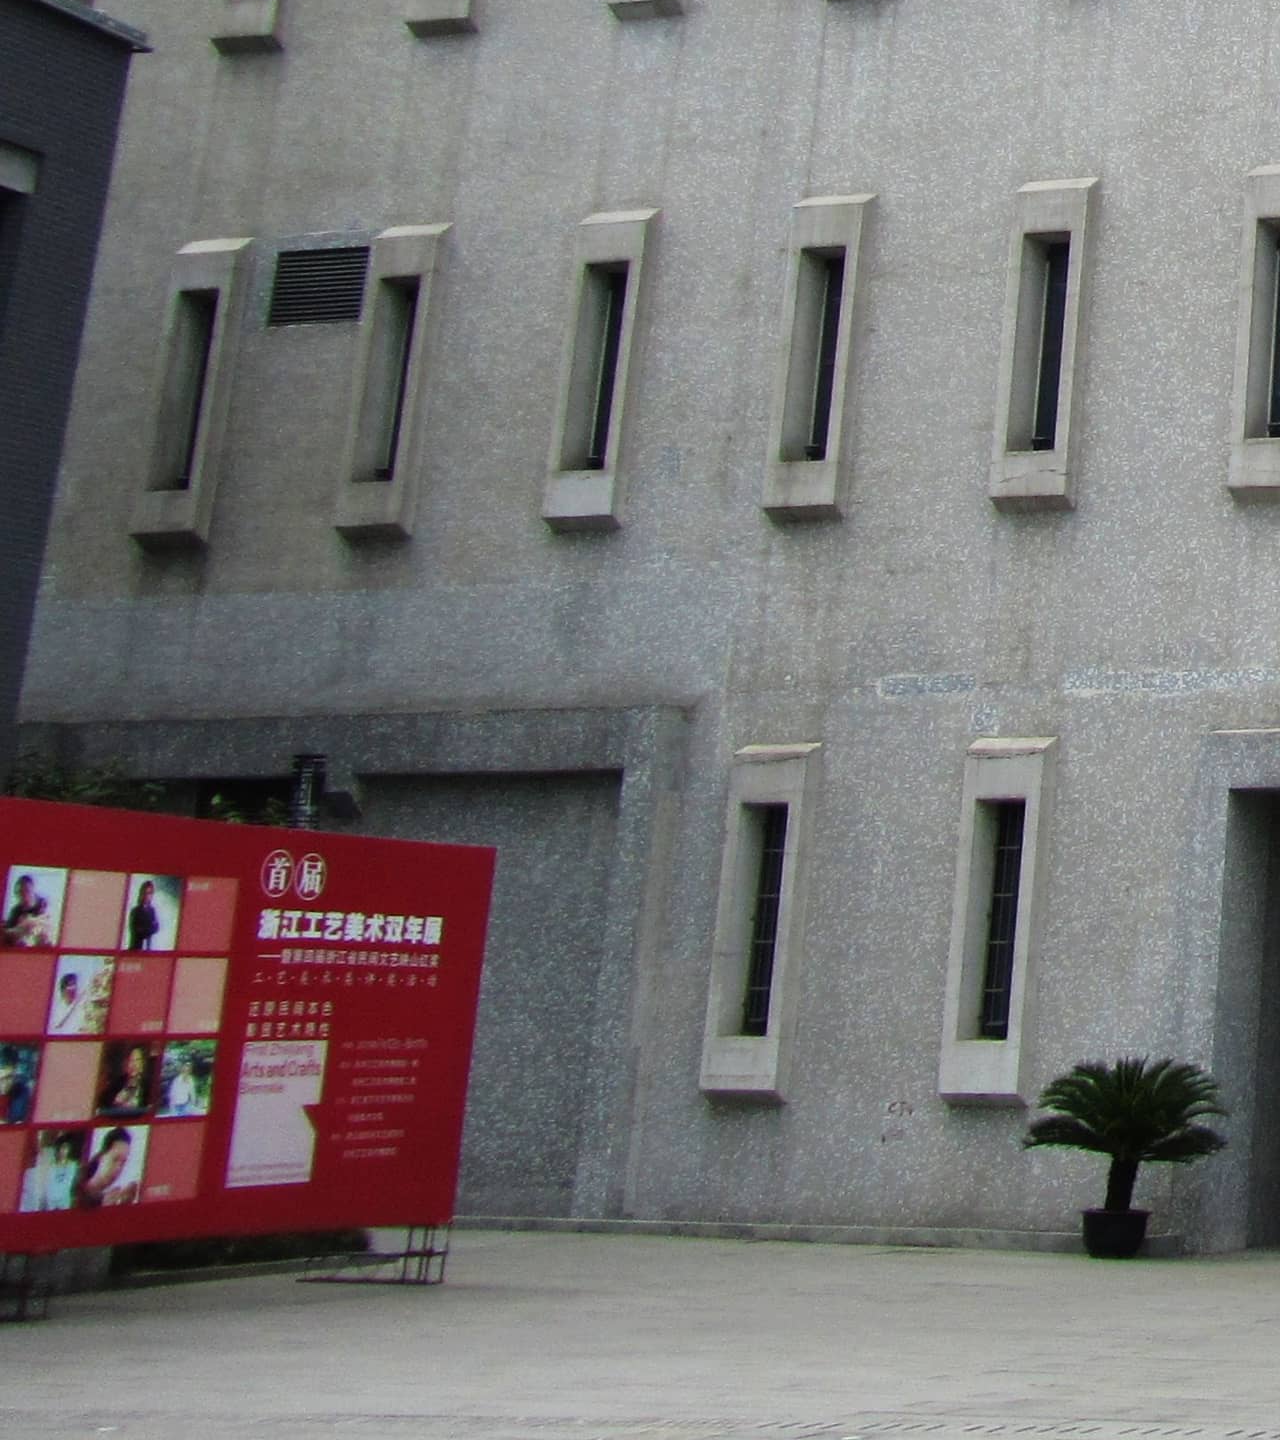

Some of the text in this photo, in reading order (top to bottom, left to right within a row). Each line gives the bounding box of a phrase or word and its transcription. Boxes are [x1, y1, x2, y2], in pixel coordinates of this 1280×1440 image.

[265, 853, 325, 897] 首届
[257, 908, 443, 945] 浙江工艺美术双年展
